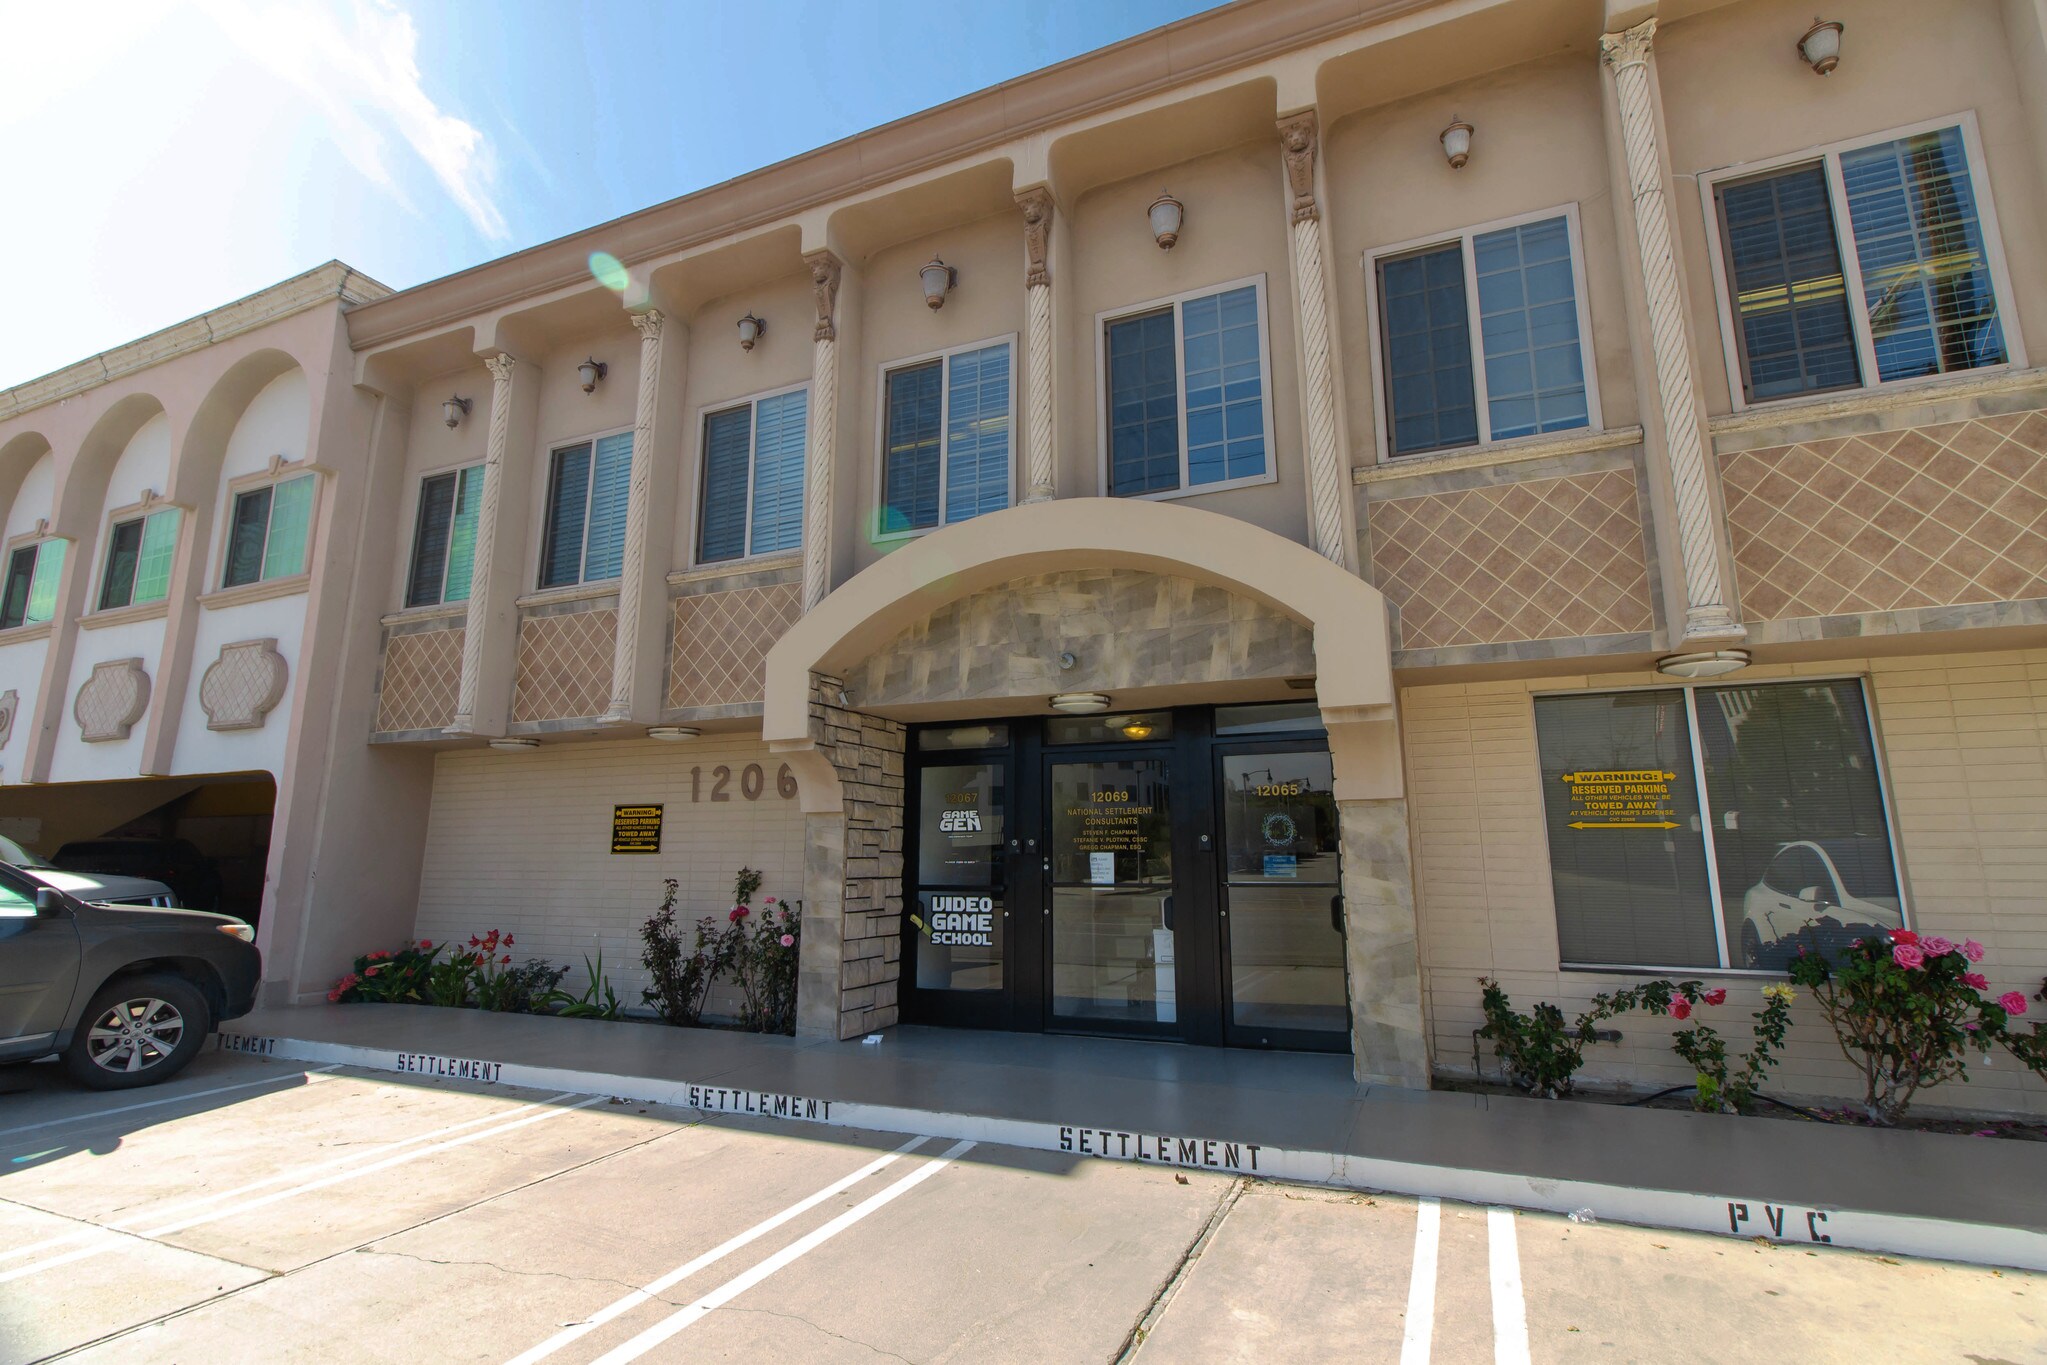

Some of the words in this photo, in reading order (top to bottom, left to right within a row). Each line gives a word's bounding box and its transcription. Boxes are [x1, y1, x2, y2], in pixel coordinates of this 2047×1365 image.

[1579, 773, 1658, 781] WARNING:
[1256, 784, 1298, 796] 12065
[1572, 785, 1622, 795] RESERVED
[1624, 784, 1668, 794] PARKING
[946, 793, 978, 804] 12067
[1091, 791, 1129, 802] 12069
[1585, 802, 1623, 810] TOWED
[1626, 801, 1657, 809] AWAY
[942, 810, 979, 819] GAME
[1067, 808, 1103, 816] NATIONAL
[1105, 807, 1153, 815] SETTLEMENT
[940, 818, 982, 831] GEN
[1085, 817, 1138, 825] CONSULTANTS
[932, 896, 993, 912] VIDEO
[932, 913, 993, 931] GAME
[931, 932, 993, 946] SCHOOL
[398, 1053, 501, 1081] SETTLEMENT
[689, 1086, 832, 1120] SETTLEMENT
[1060, 1127, 1261, 1170] SETTLEMENT
